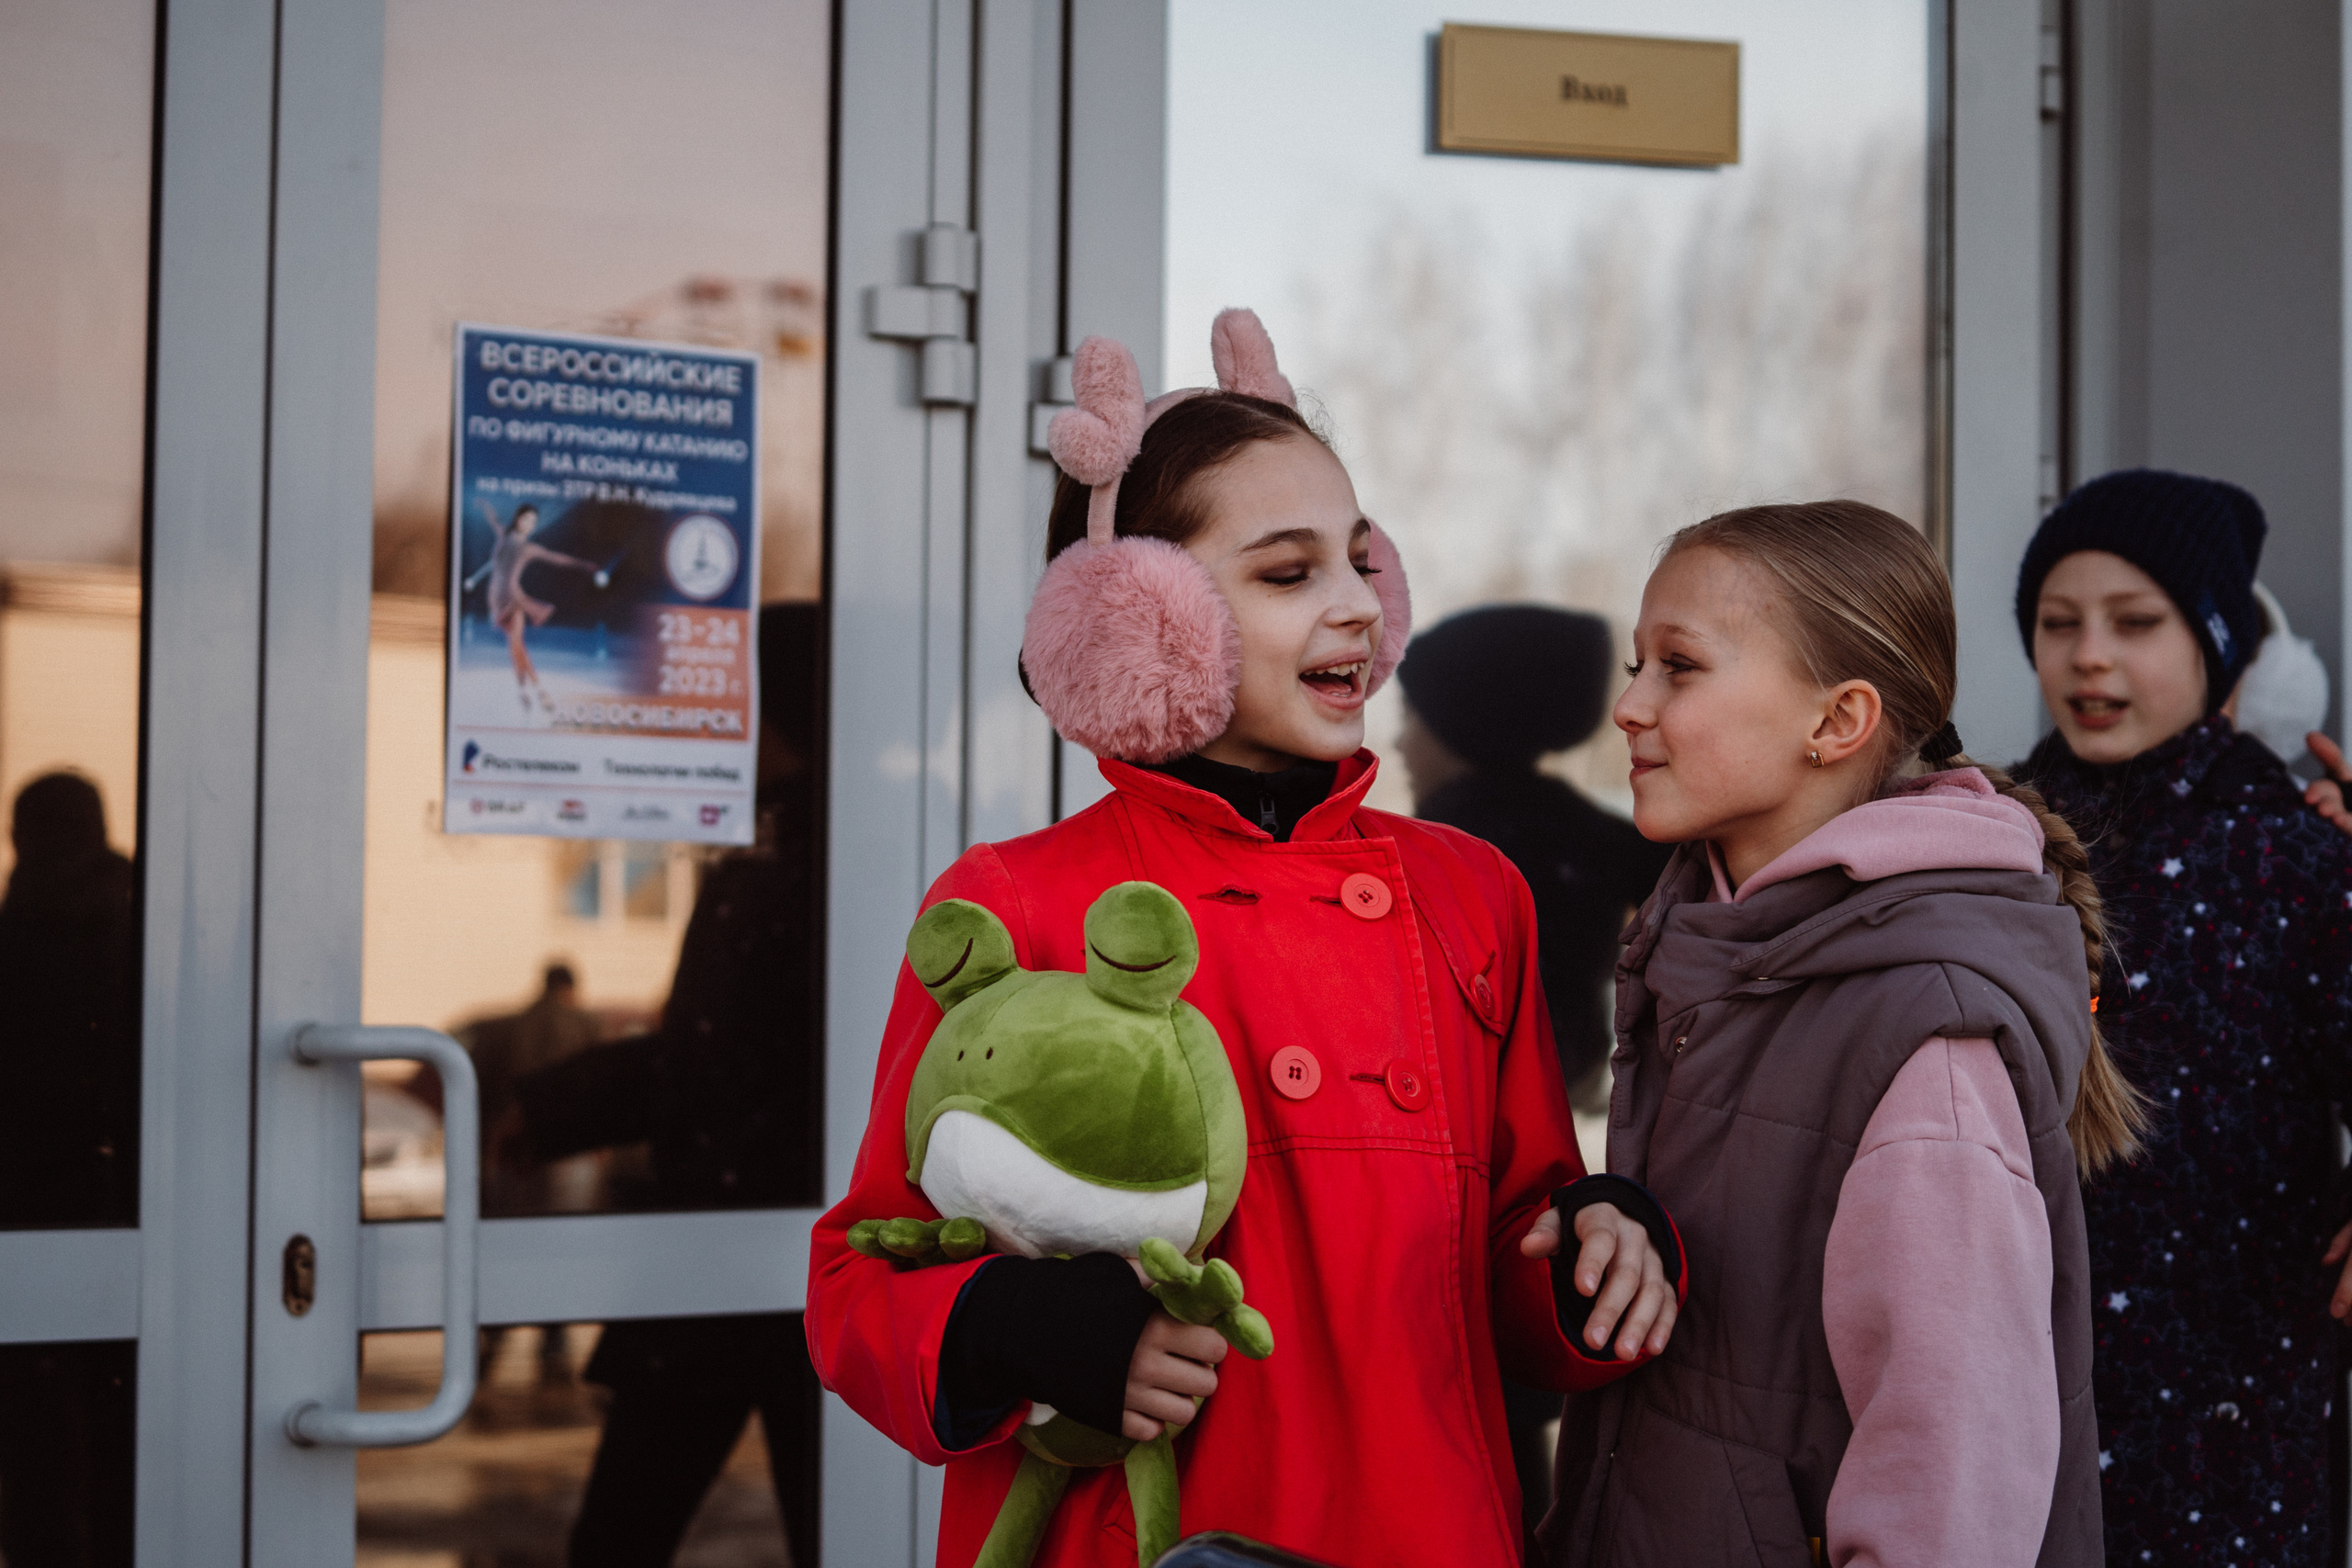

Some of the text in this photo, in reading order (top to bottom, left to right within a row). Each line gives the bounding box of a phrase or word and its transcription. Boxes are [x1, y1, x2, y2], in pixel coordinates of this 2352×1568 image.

[1561, 74, 1628, 107] Вход
[480, 341, 741, 394] ВСЕРОССИЙСКИЕ
[487, 377, 733, 426] СОРЕВНОВАНИЯ
[468, 415, 748, 462] ПО ФИГУРНОМУ КАТАНИЮ
[540, 451, 678, 484] НА КОНЬКАХ
[659, 614, 739, 645] 23-24
[658, 665, 727, 695] 2023
[553, 703, 742, 732] НОВОСИБИРСК
